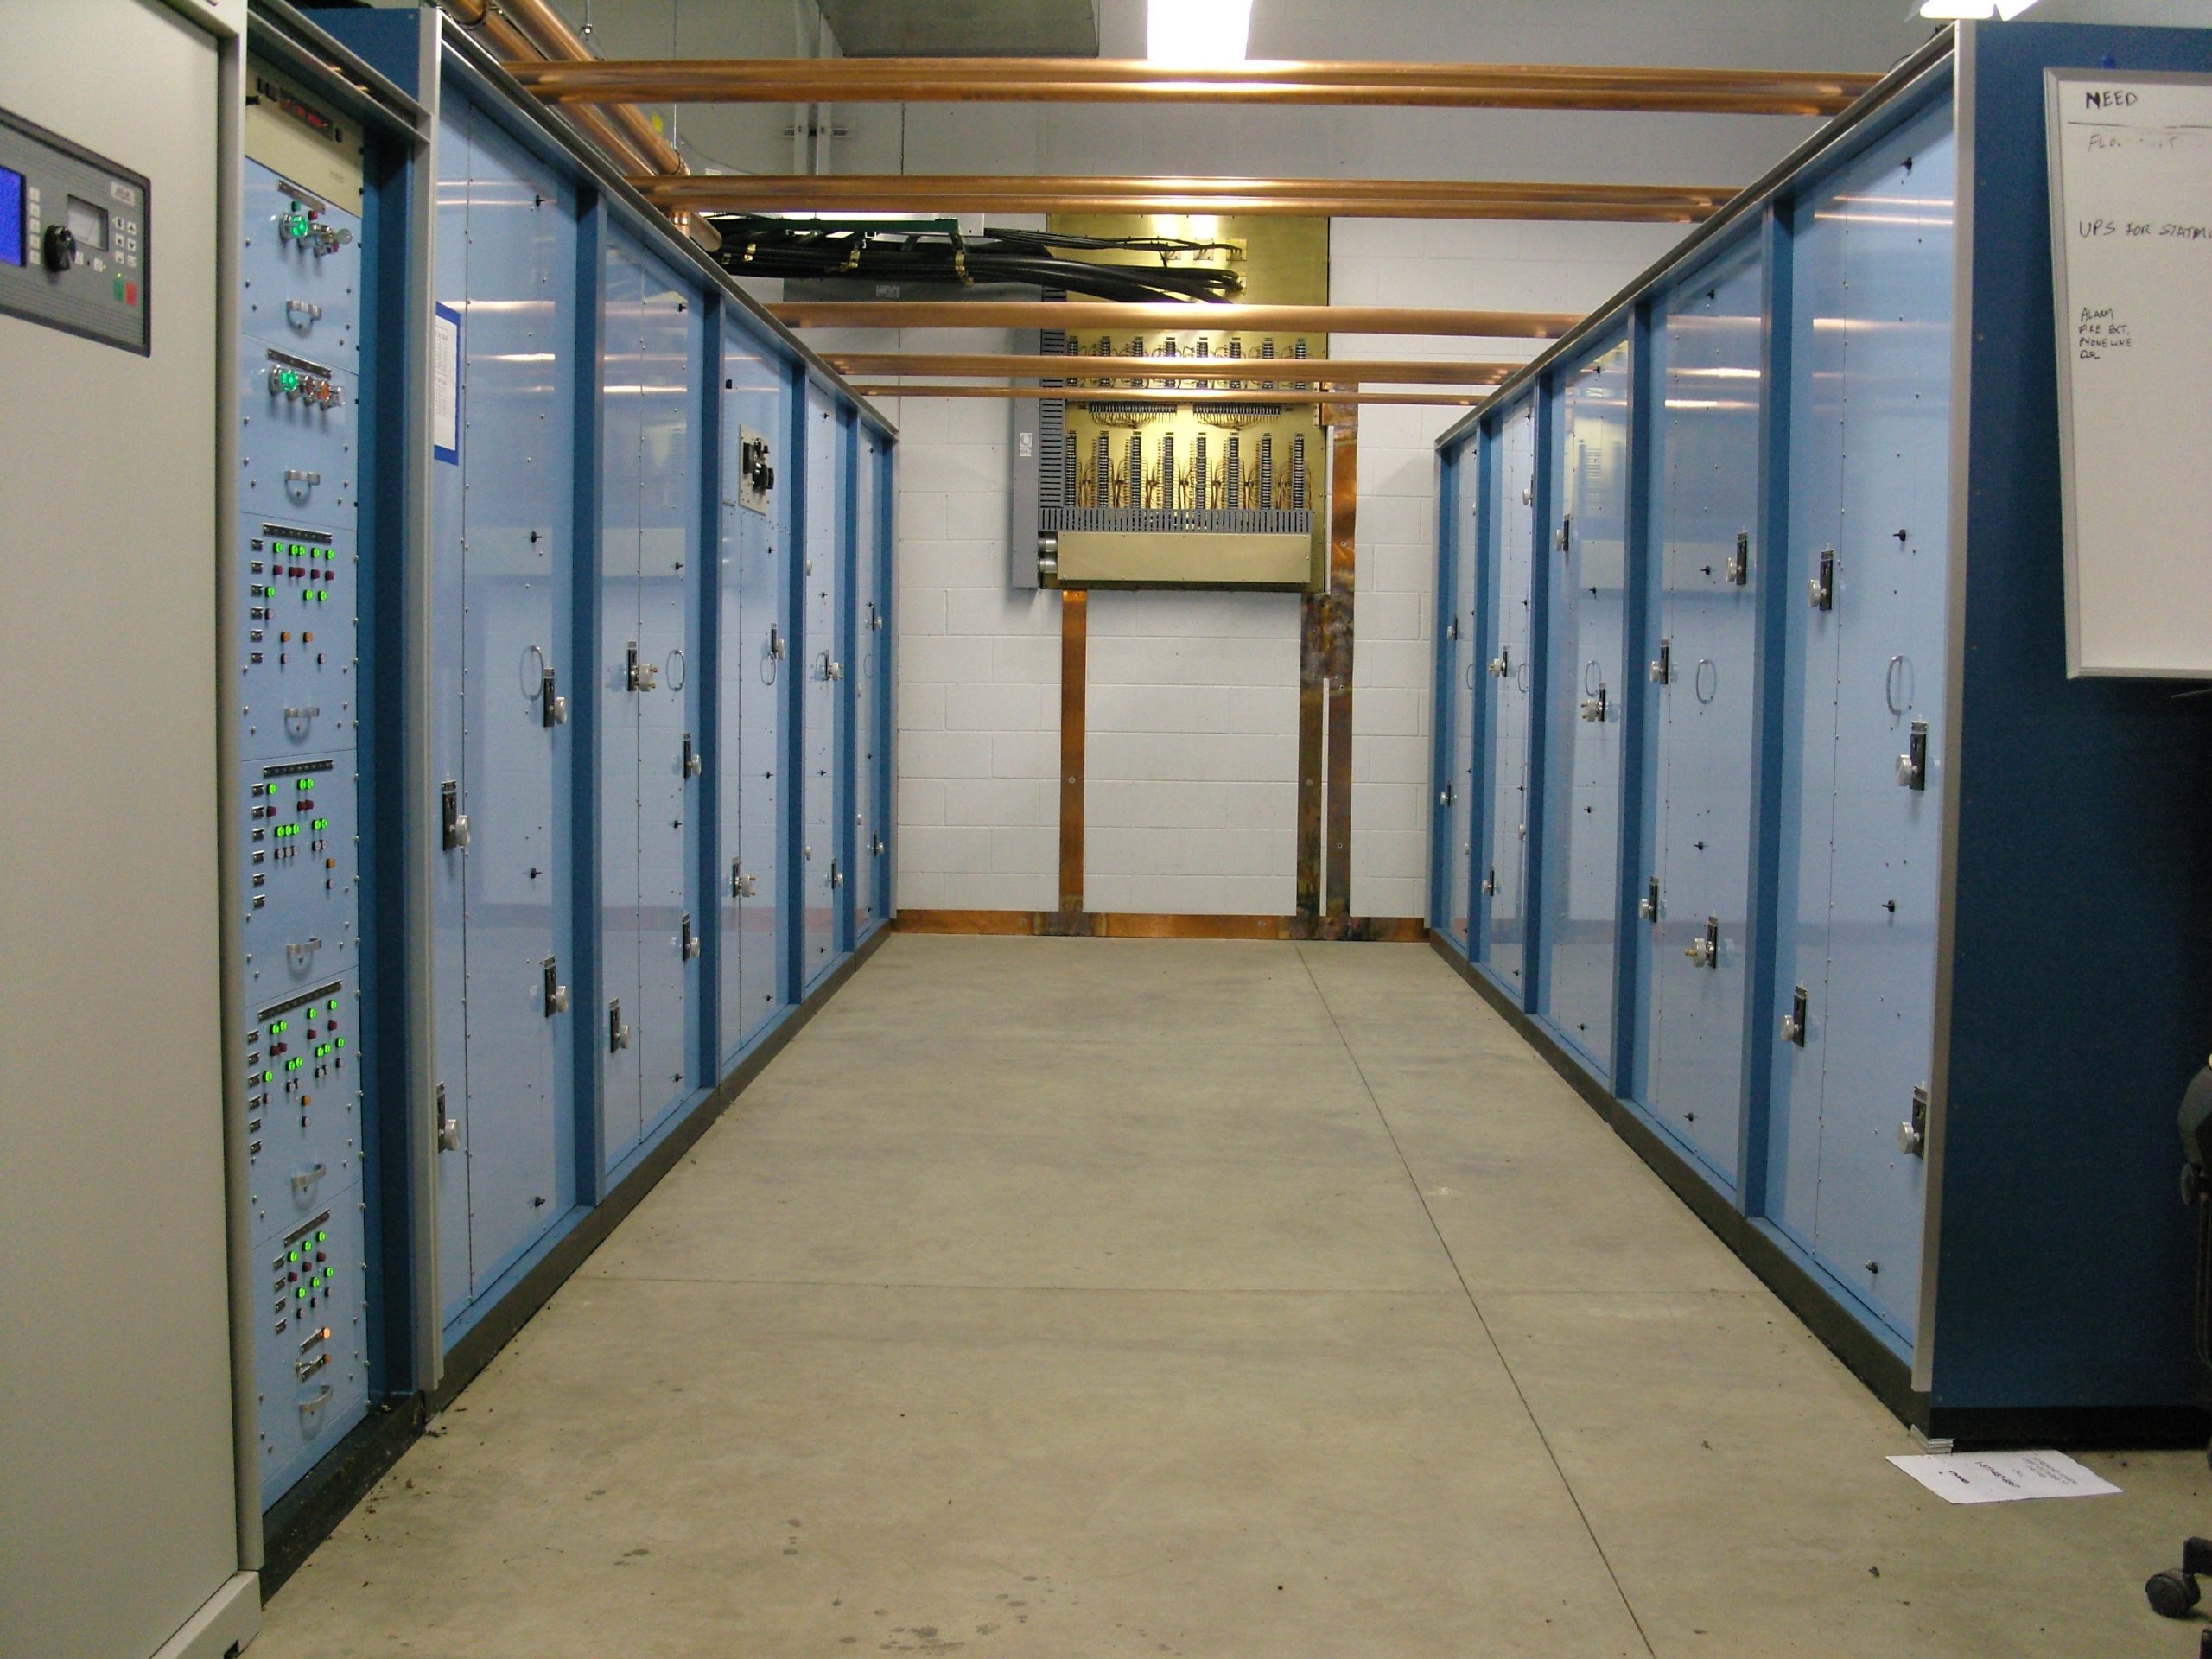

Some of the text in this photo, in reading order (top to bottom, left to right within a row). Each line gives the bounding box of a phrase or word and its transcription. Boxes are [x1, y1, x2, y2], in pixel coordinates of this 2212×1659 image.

[2086, 91, 2138, 109] NEED
[2079, 219, 2115, 238] UPS
[2126, 222, 2151, 236] FOR
[2081, 307, 2114, 322] ALARM
